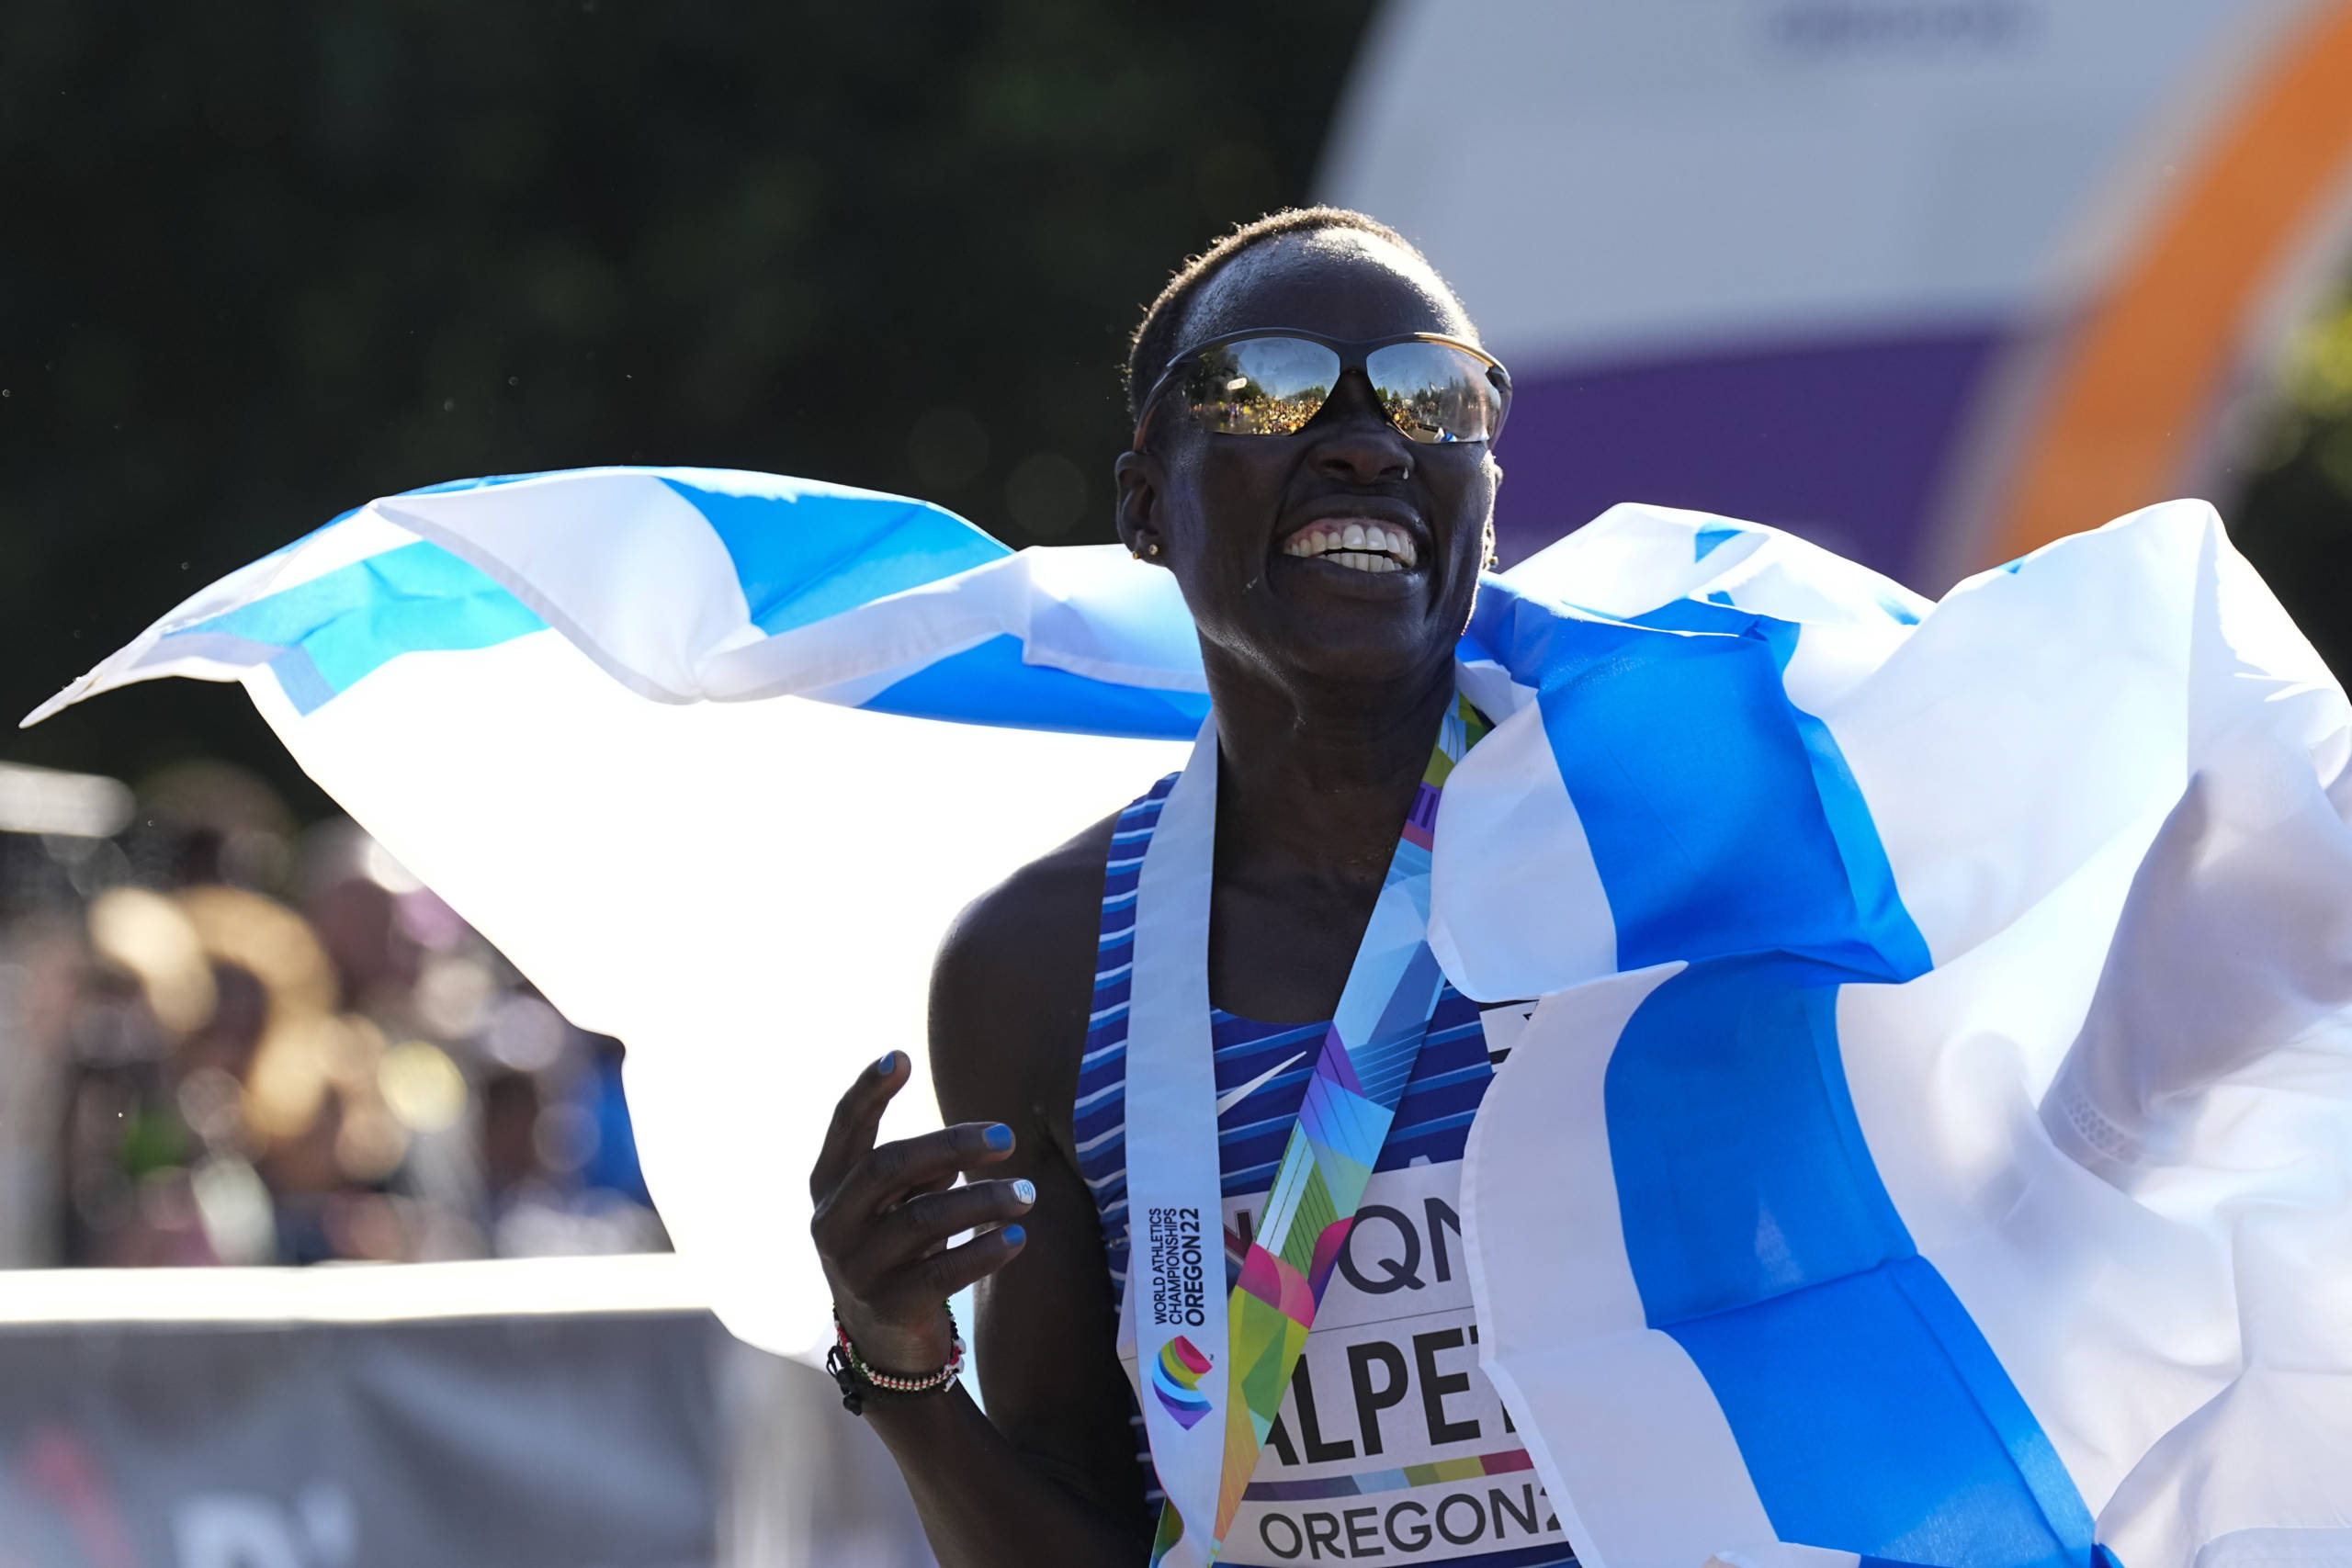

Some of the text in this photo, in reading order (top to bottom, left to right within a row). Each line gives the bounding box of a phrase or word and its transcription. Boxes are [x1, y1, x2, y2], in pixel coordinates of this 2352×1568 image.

[1148, 1208, 1168, 1325] WORLD ATHLETICS
[1163, 1208, 1183, 1325] CHAMPIONSHIPS
[1179, 1208, 1205, 1326] OREGON22
[1265, 1325, 1517, 1466] LPE
